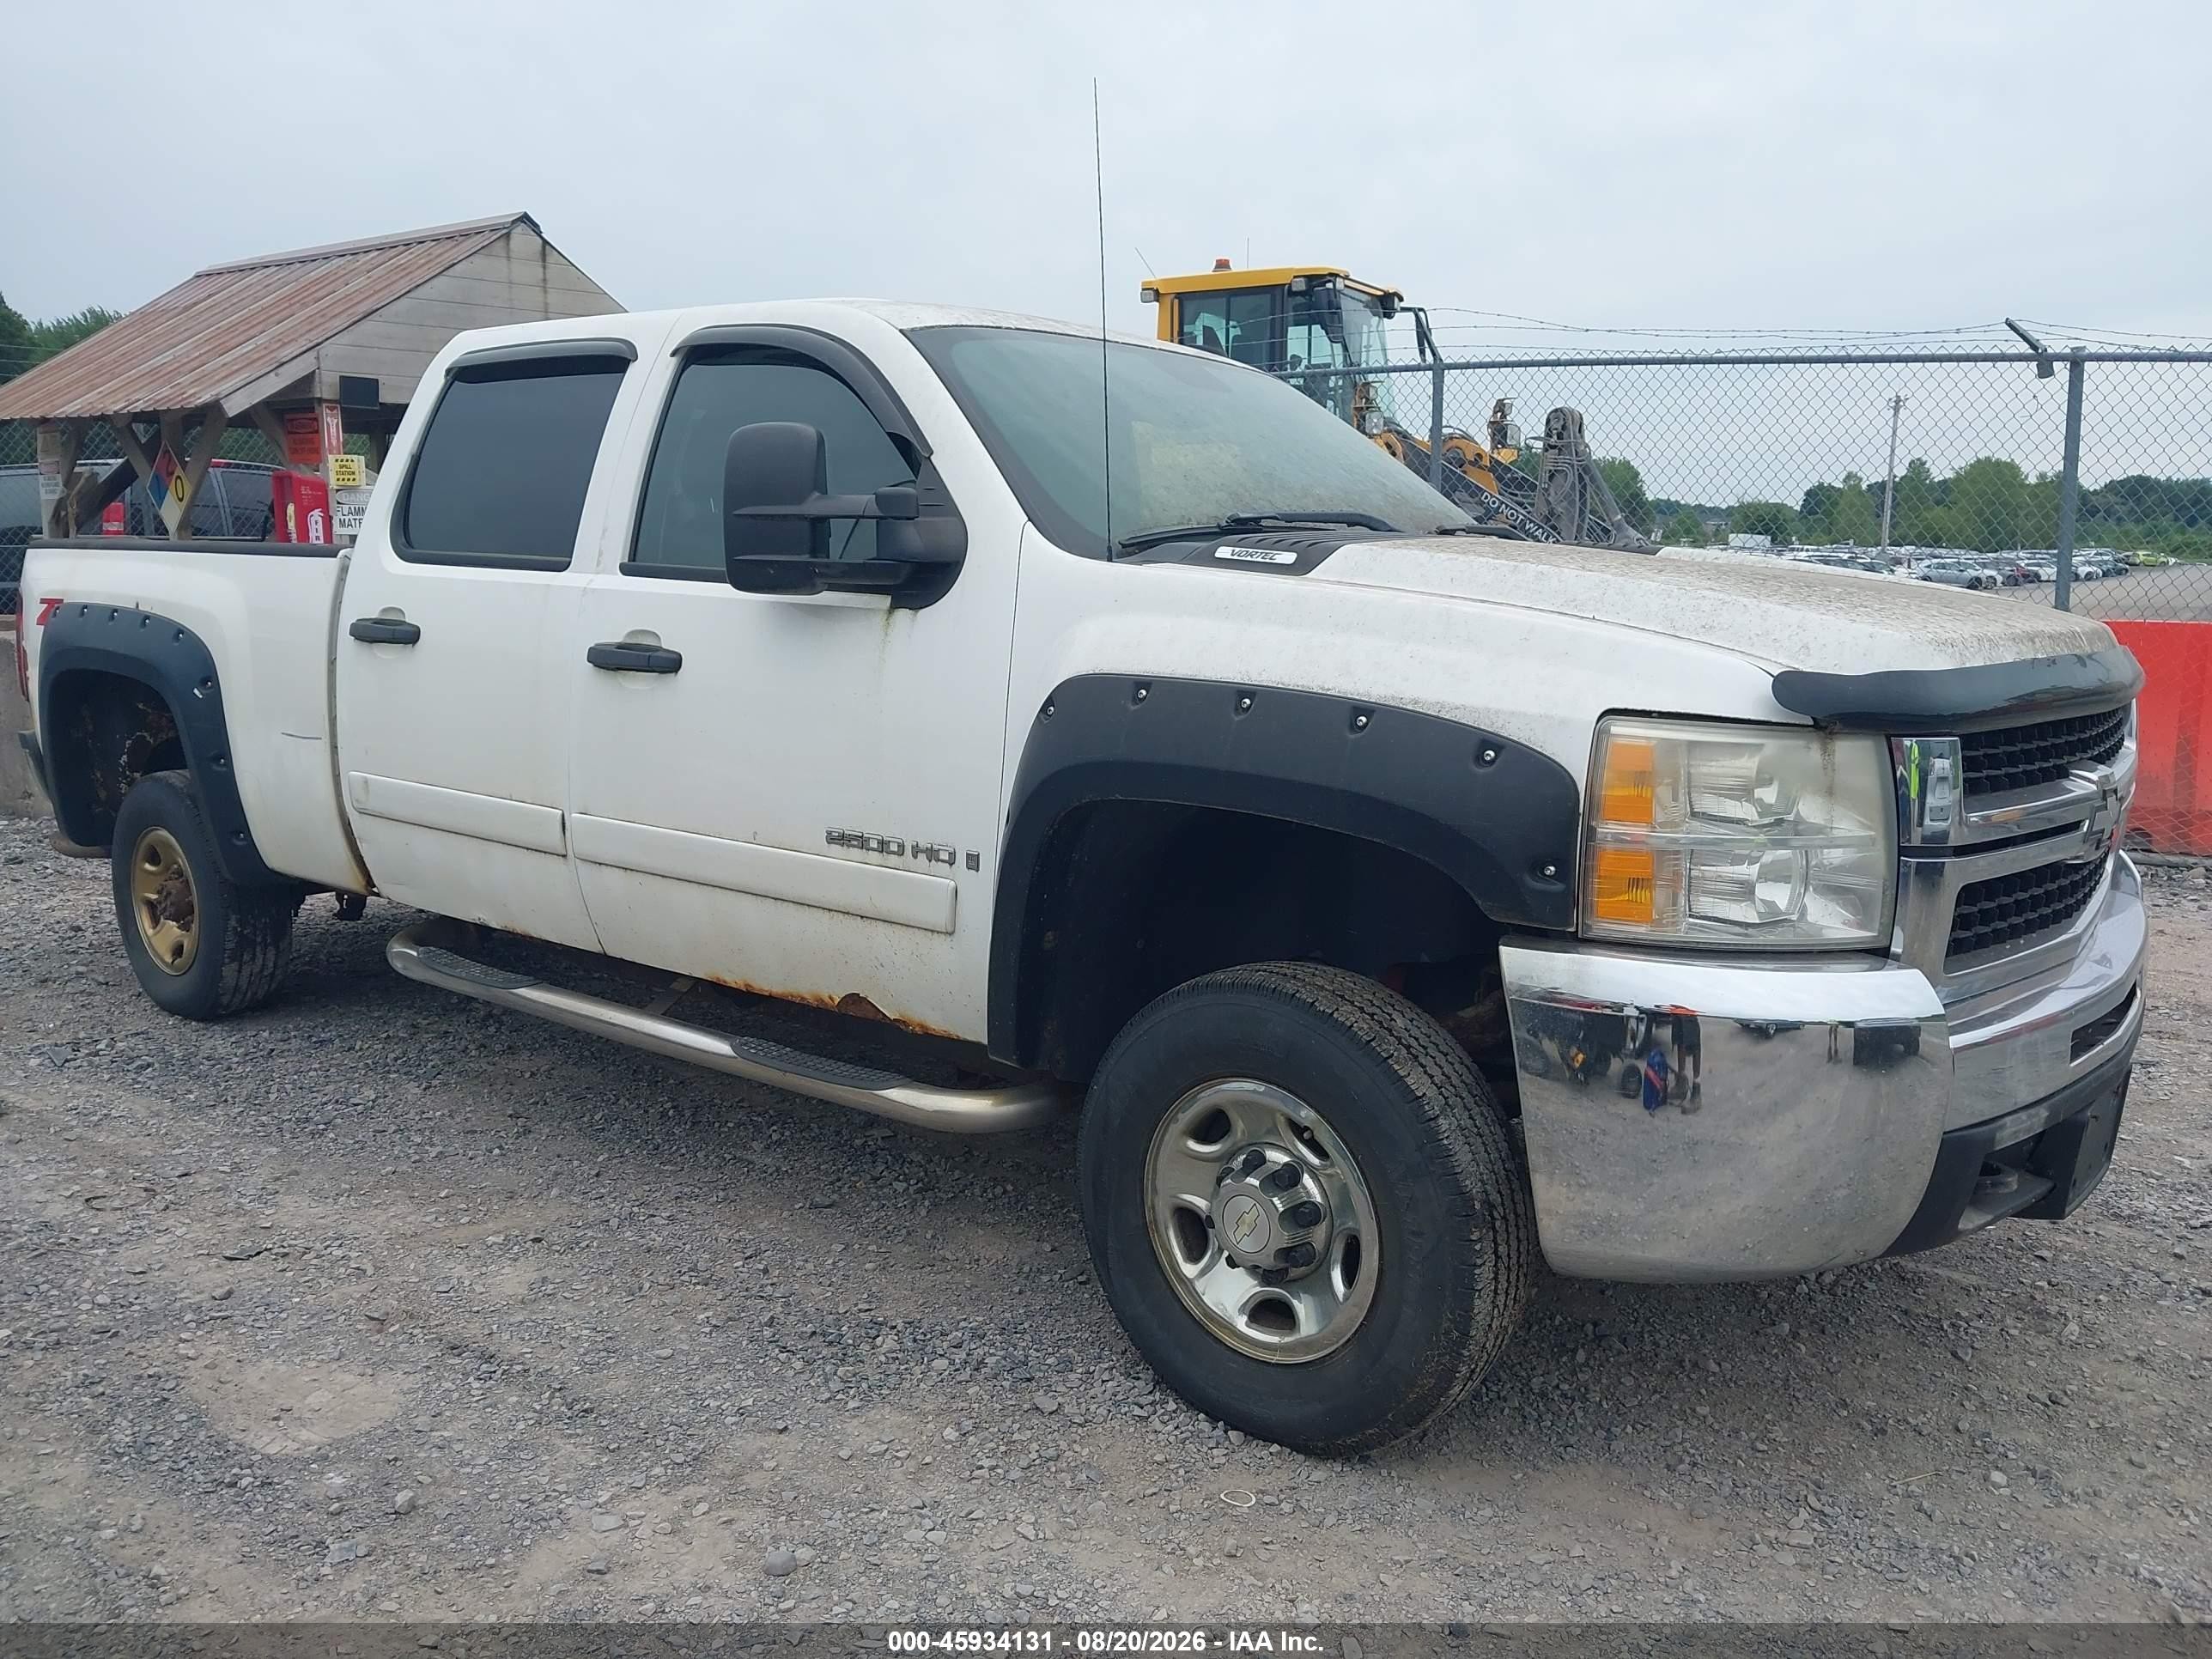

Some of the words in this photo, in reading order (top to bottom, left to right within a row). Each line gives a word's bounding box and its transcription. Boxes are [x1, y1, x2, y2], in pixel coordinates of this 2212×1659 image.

[174, 474, 185, 502] 0
[1481, 492, 1498, 507] DO
[1498, 503, 1525, 525] NOT
[1525, 520, 1557, 544] WALK
[1230, 549, 1283, 560] VORTEC
[825, 827, 905, 857] 2500
[911, 840, 957, 866] HD
